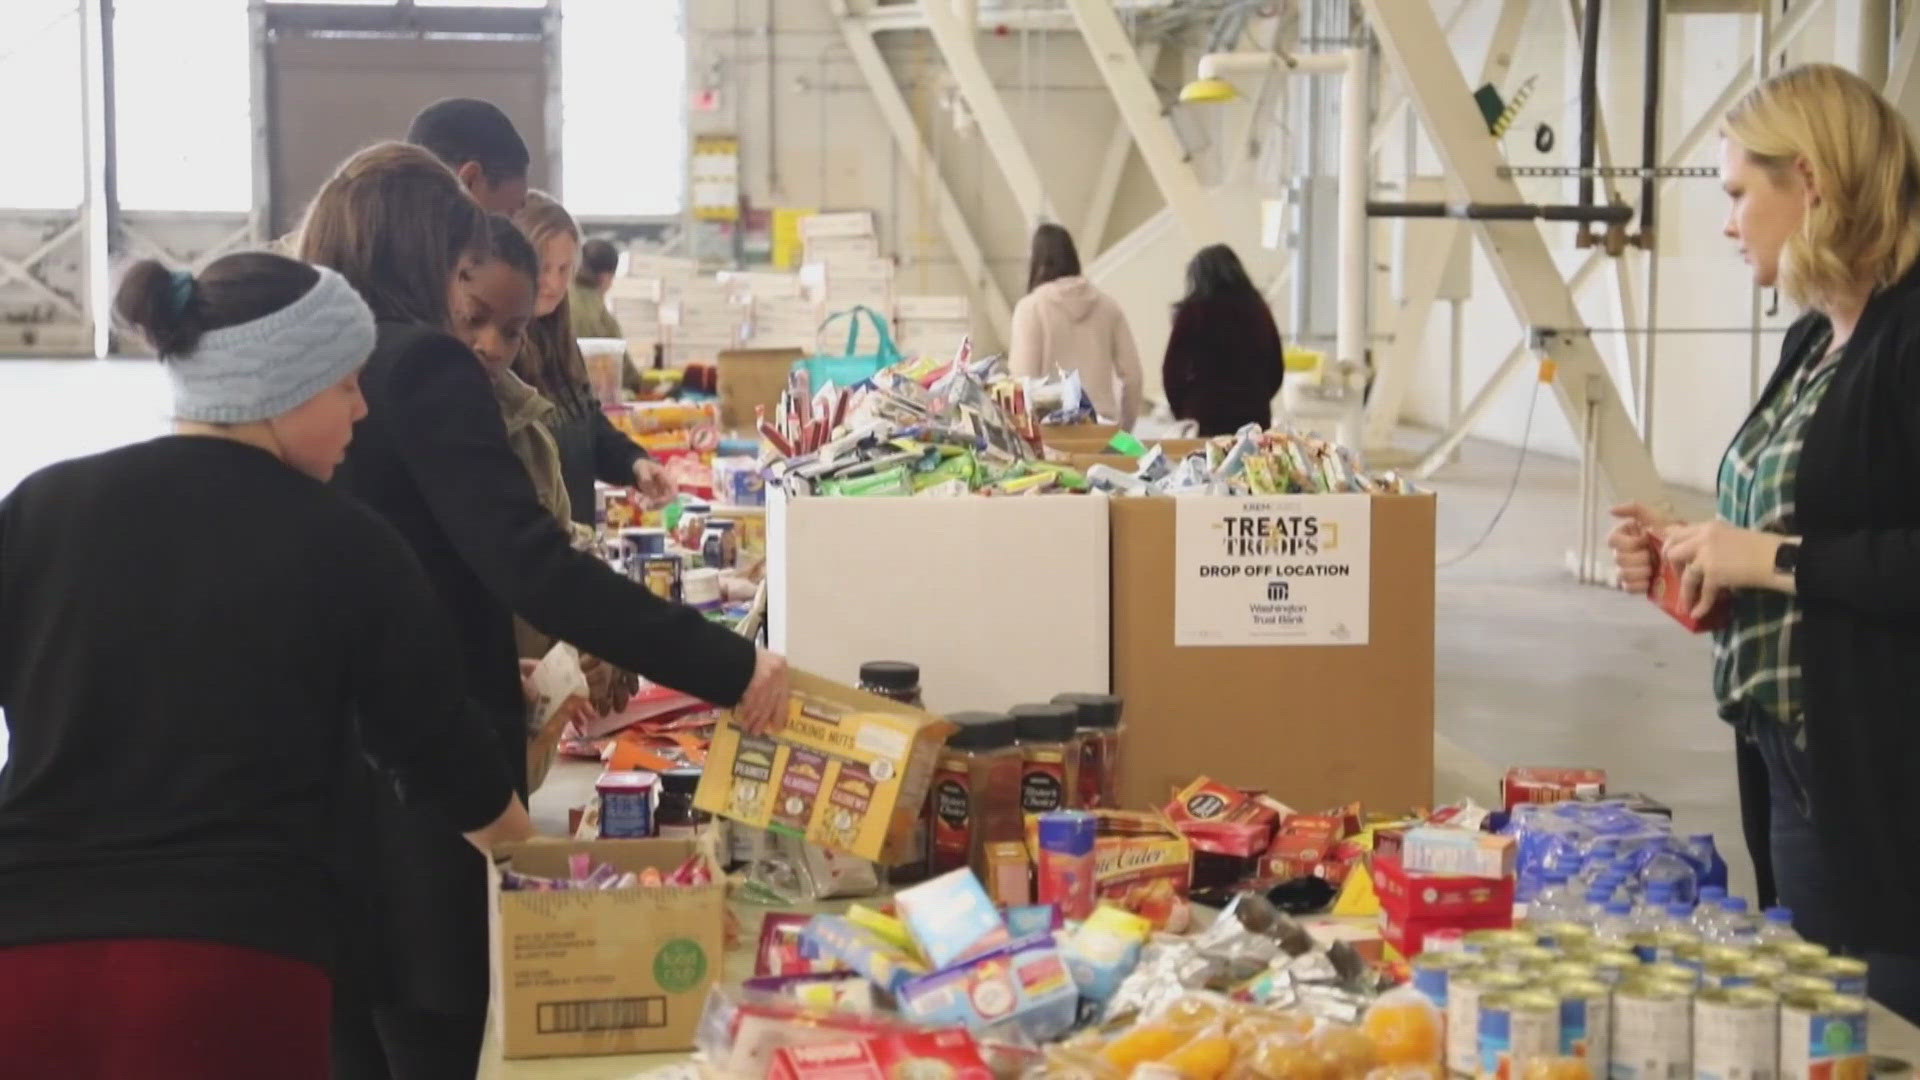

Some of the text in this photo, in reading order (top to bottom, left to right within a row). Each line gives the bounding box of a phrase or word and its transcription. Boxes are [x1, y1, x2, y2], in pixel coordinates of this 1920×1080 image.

[1223, 516, 1318, 538] TREATS
[1199, 563, 1350, 577] DROP OFF LOCATION
[1248, 602, 1308, 616] Washington
[1252, 614, 1304, 625] Trust Bank
[788, 718, 856, 751] ACKING NUTS
